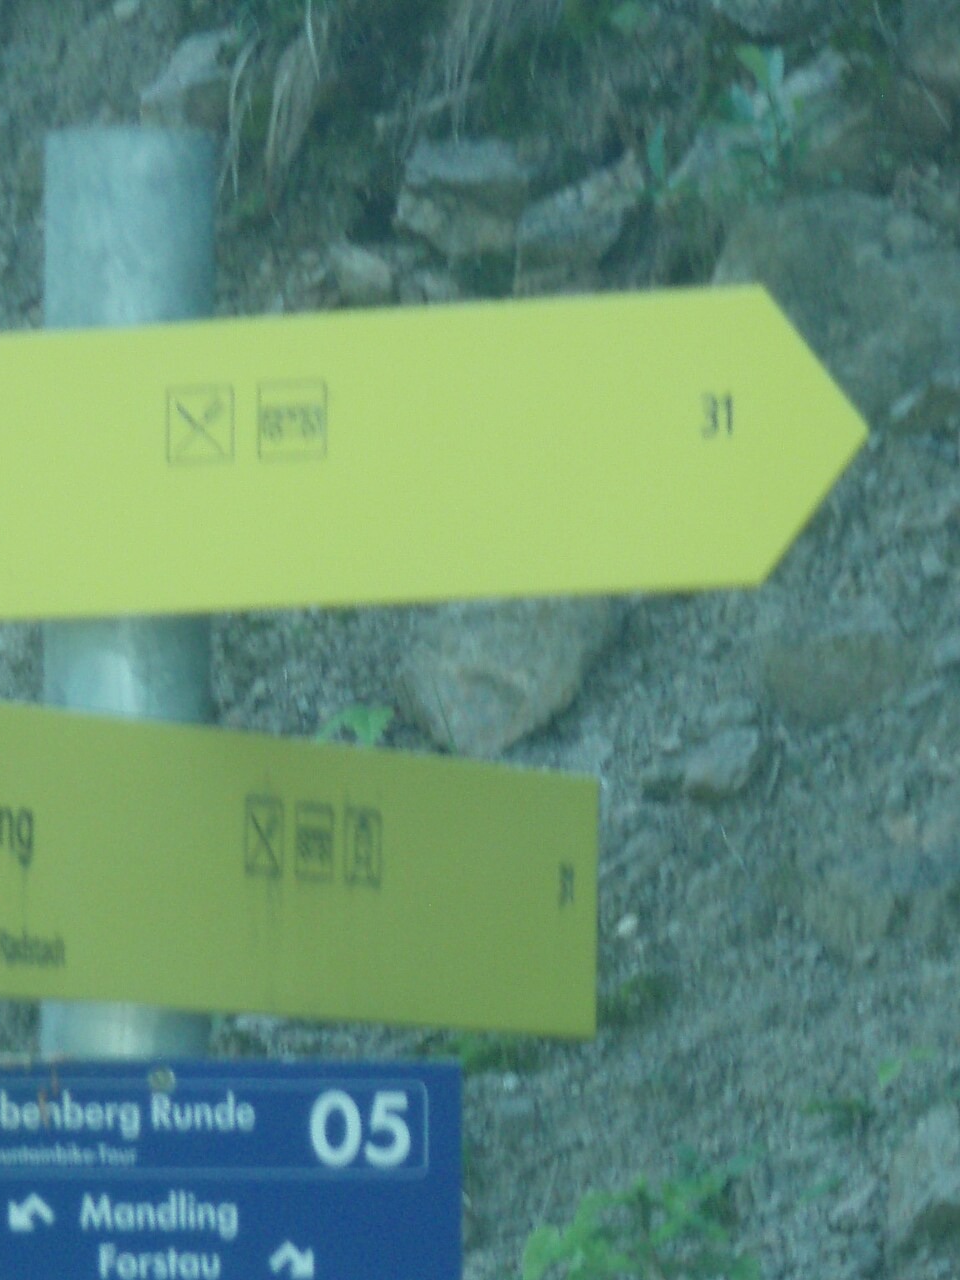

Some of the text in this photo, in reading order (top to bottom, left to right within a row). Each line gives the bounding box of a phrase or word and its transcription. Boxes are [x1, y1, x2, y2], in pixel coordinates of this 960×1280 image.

[700, 392, 734, 440] 31
[151, 1089, 256, 1133] Runde
[310, 1090, 411, 1166] 05
[80, 1192, 240, 1240] Mandling
[98, 1244, 221, 1280] Forstau
